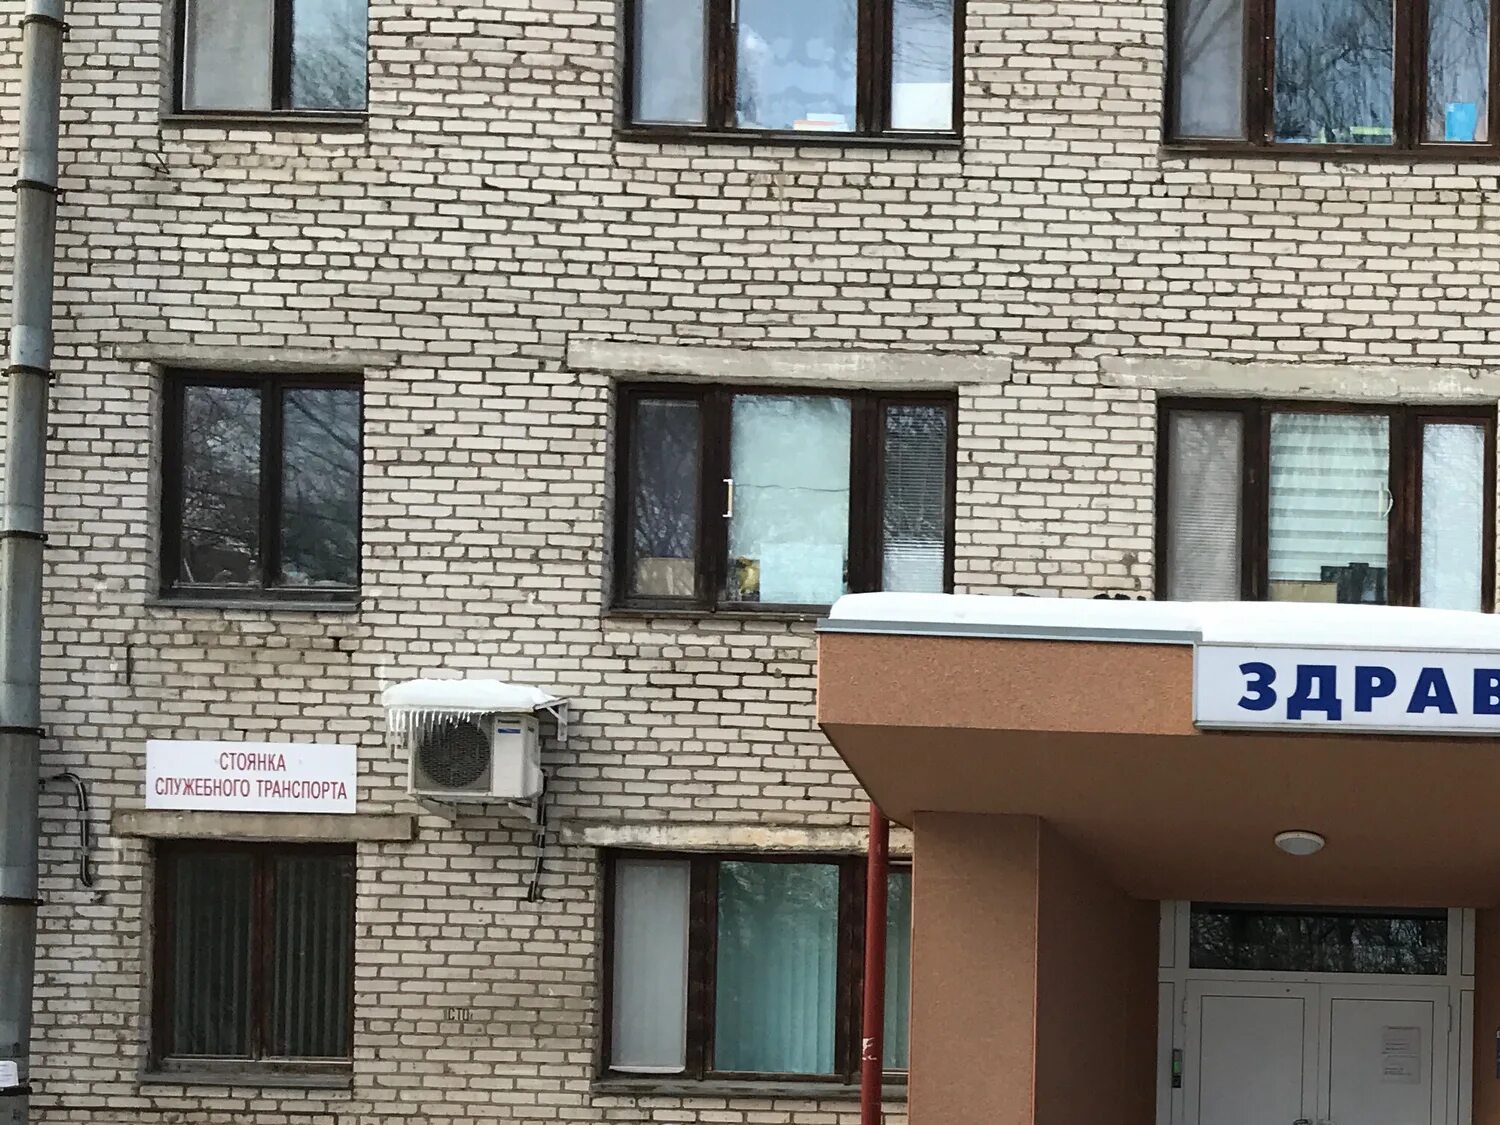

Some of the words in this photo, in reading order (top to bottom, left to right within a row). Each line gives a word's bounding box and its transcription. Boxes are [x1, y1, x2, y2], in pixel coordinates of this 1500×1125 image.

[219, 752, 287, 772] СТОЯНКА
[155, 777, 250, 797] СЛУЖЕБНОГО
[256, 780, 347, 800] ТРАНСПОРТА
